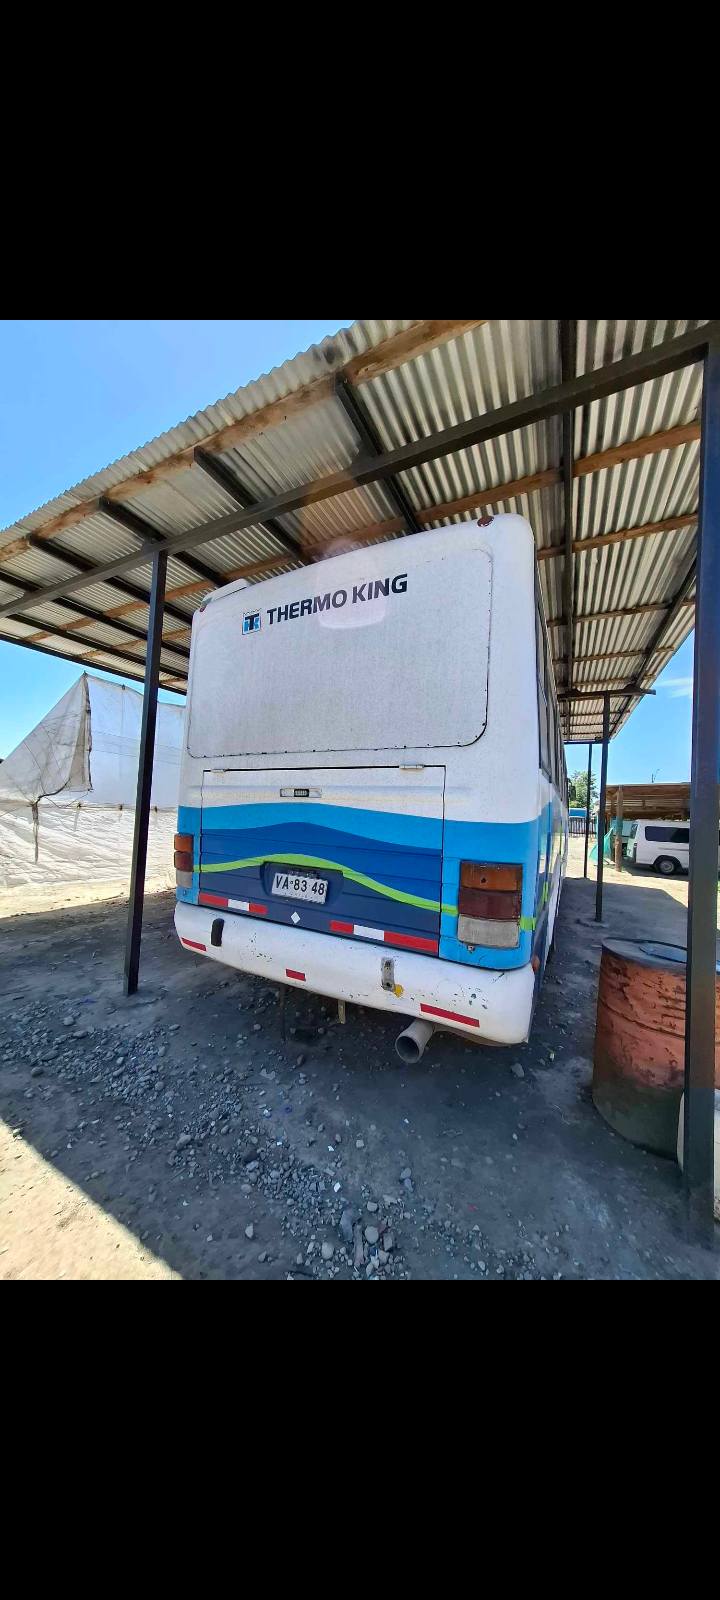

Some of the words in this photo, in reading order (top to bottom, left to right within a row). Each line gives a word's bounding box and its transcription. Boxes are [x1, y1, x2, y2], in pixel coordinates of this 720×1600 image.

[266, 589, 348, 625] THERMO
[351, 573, 408, 604] KING
[311, 881, 325, 896] 48
